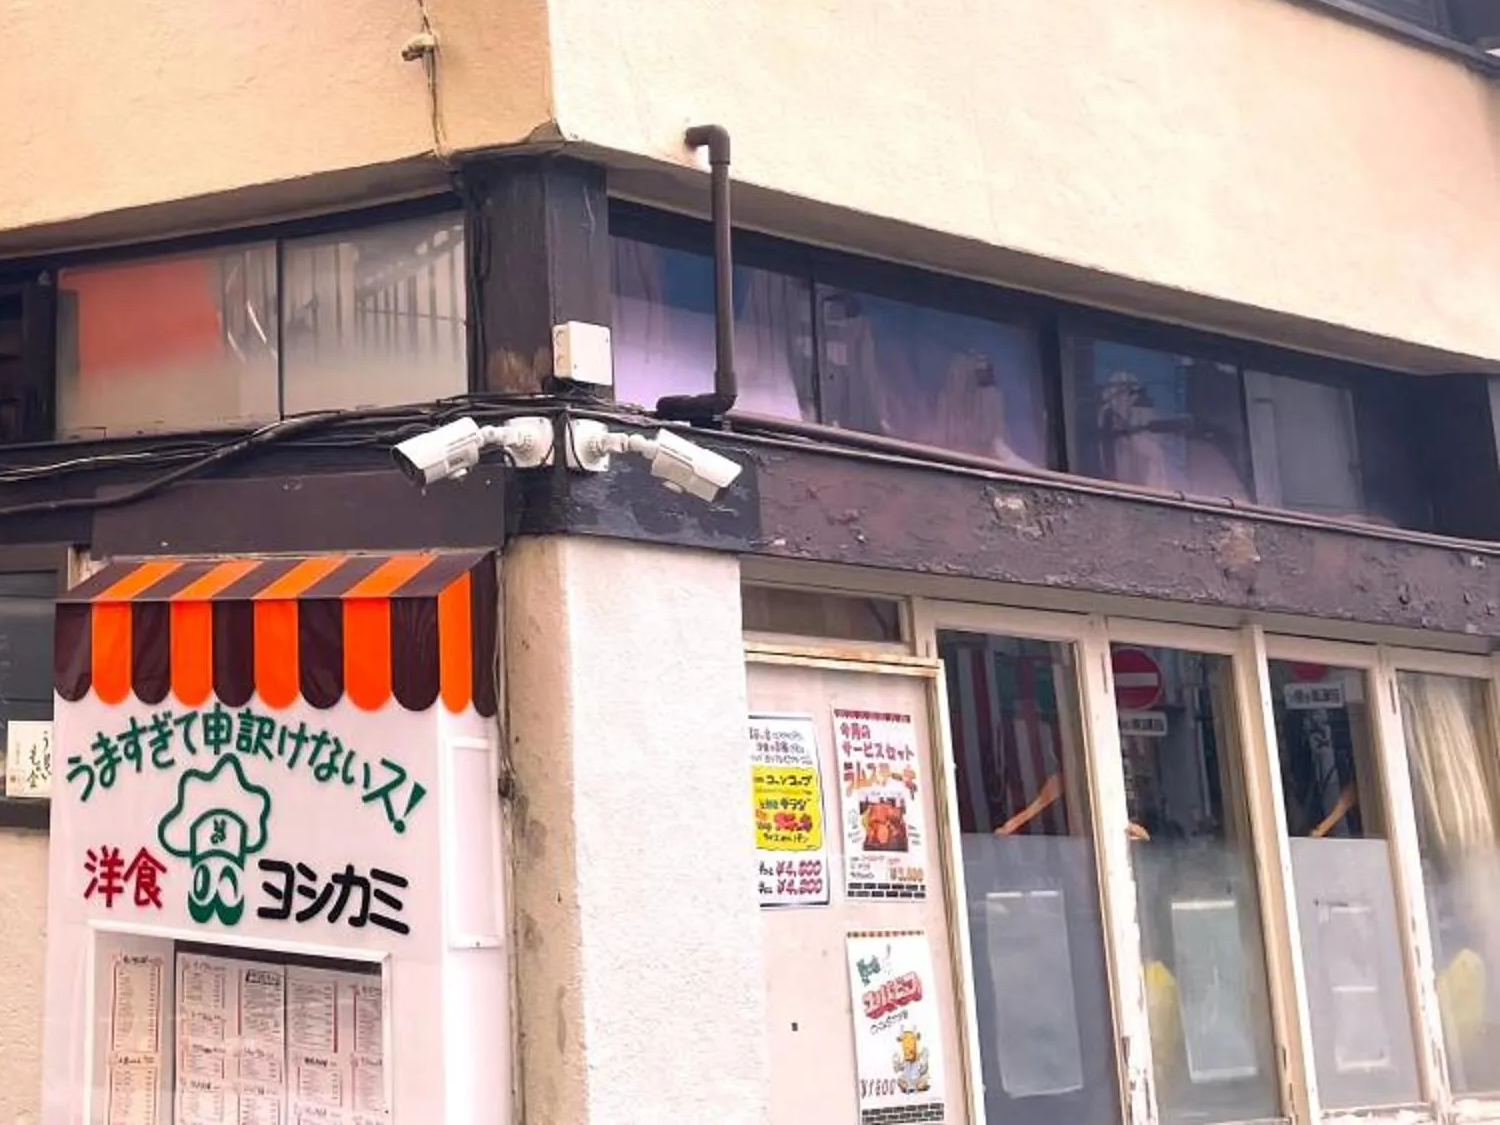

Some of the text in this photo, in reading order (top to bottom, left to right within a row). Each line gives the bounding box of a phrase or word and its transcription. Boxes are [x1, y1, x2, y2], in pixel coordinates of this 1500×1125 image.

[83, 844, 168, 910] 洋食
[257, 858, 411, 936] ヨシカミ
